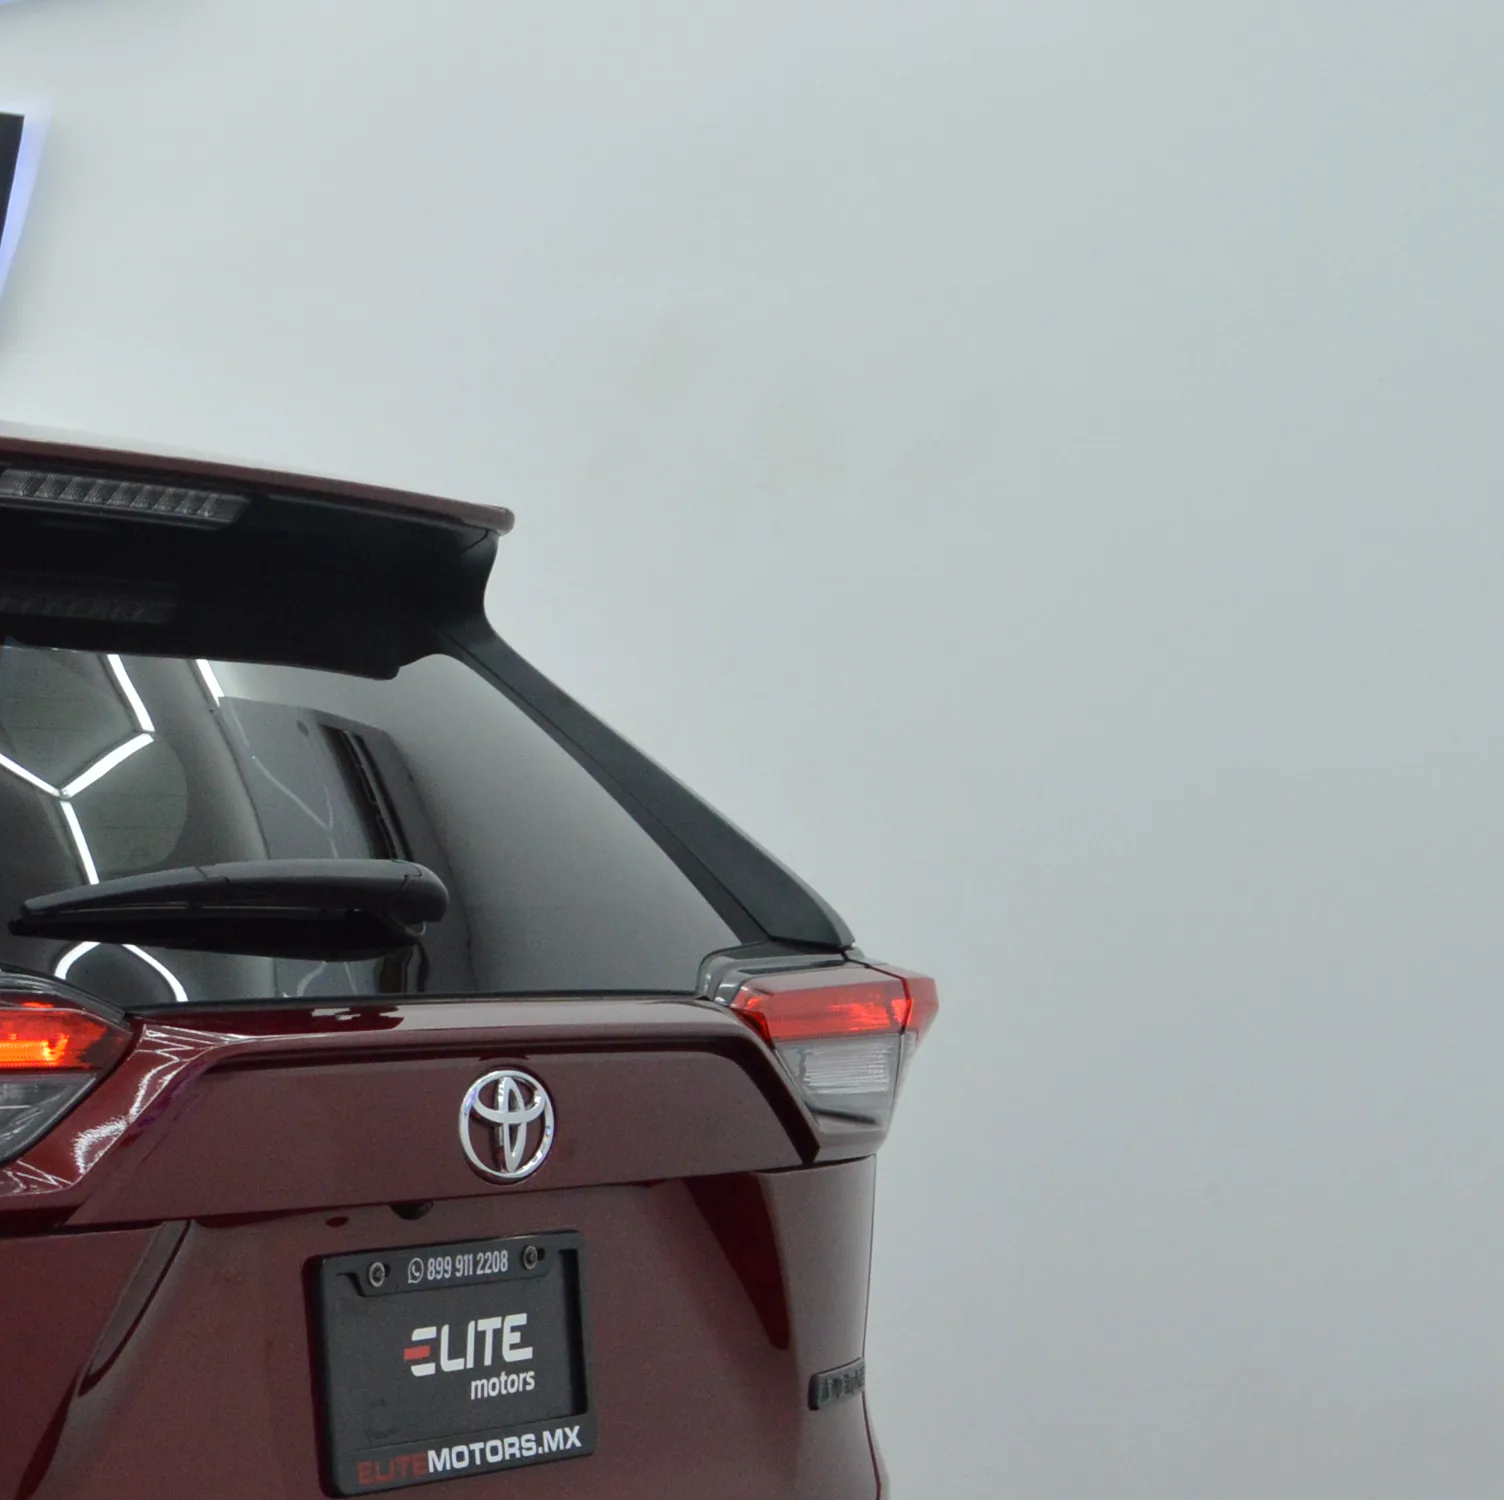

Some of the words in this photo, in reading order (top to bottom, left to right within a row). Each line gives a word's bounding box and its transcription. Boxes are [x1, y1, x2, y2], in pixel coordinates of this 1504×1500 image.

[427, 1257, 452, 1280] 899
[455, 1254, 474, 1276] 911
[476, 1250, 509, 1274] 2208
[404, 1313, 533, 1376] ELITE
[470, 1370, 535, 1401] motors
[356, 1425, 582, 1486] ELITEMOTORS.MX
